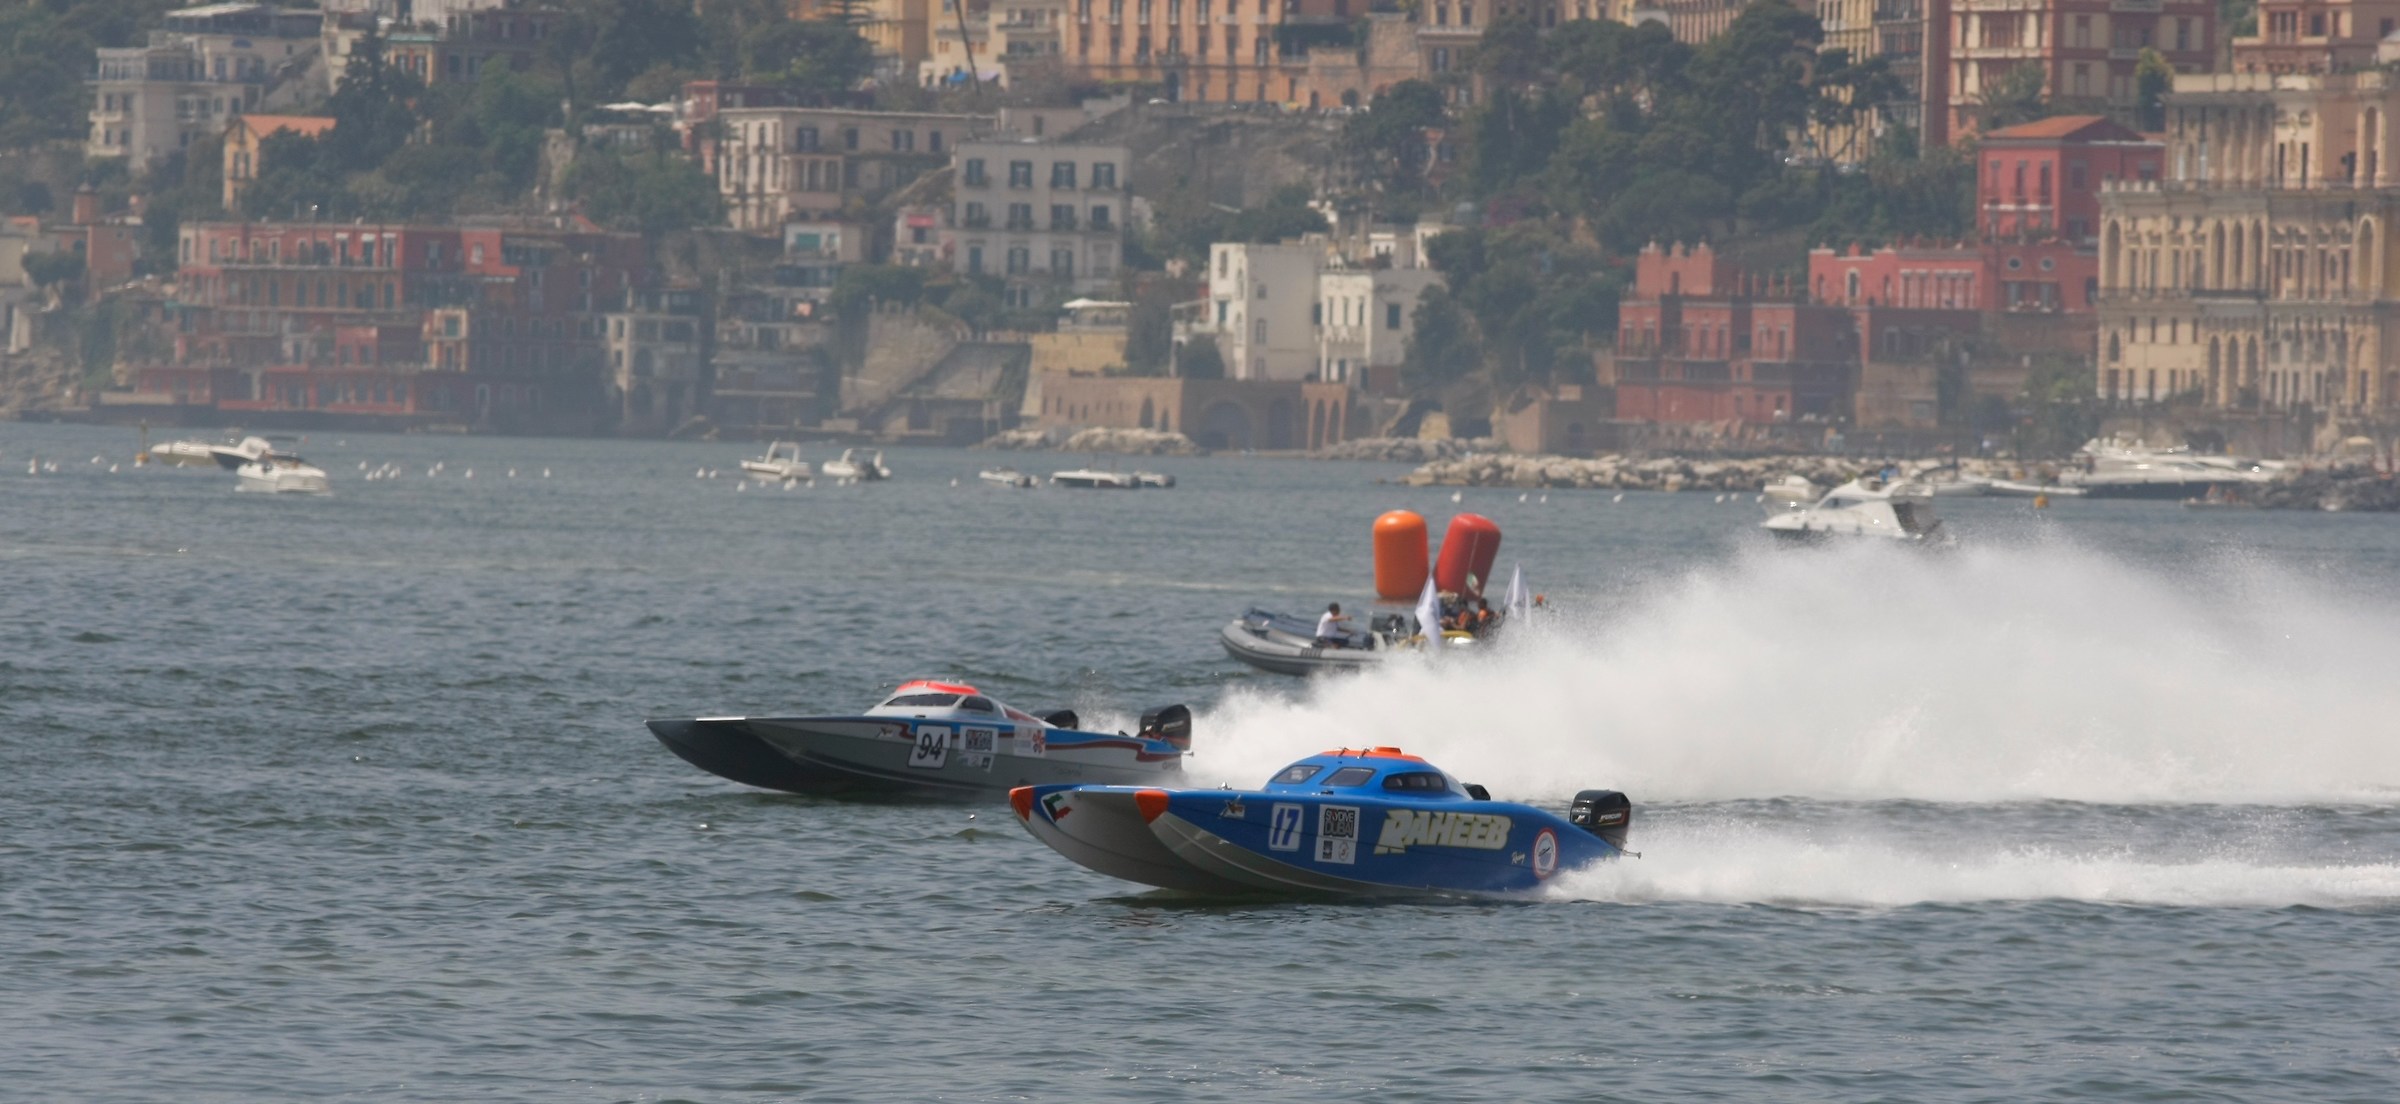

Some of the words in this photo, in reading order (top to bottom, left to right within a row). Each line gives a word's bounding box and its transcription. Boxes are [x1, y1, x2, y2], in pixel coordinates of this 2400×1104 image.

[917, 732, 944, 760] 94
[1272, 807, 1300, 846] 17
[1324, 808, 1355, 822] SKYDIVE
[1324, 821, 1354, 838] DUBAI
[1374, 809, 1512, 855] RAHEEB
